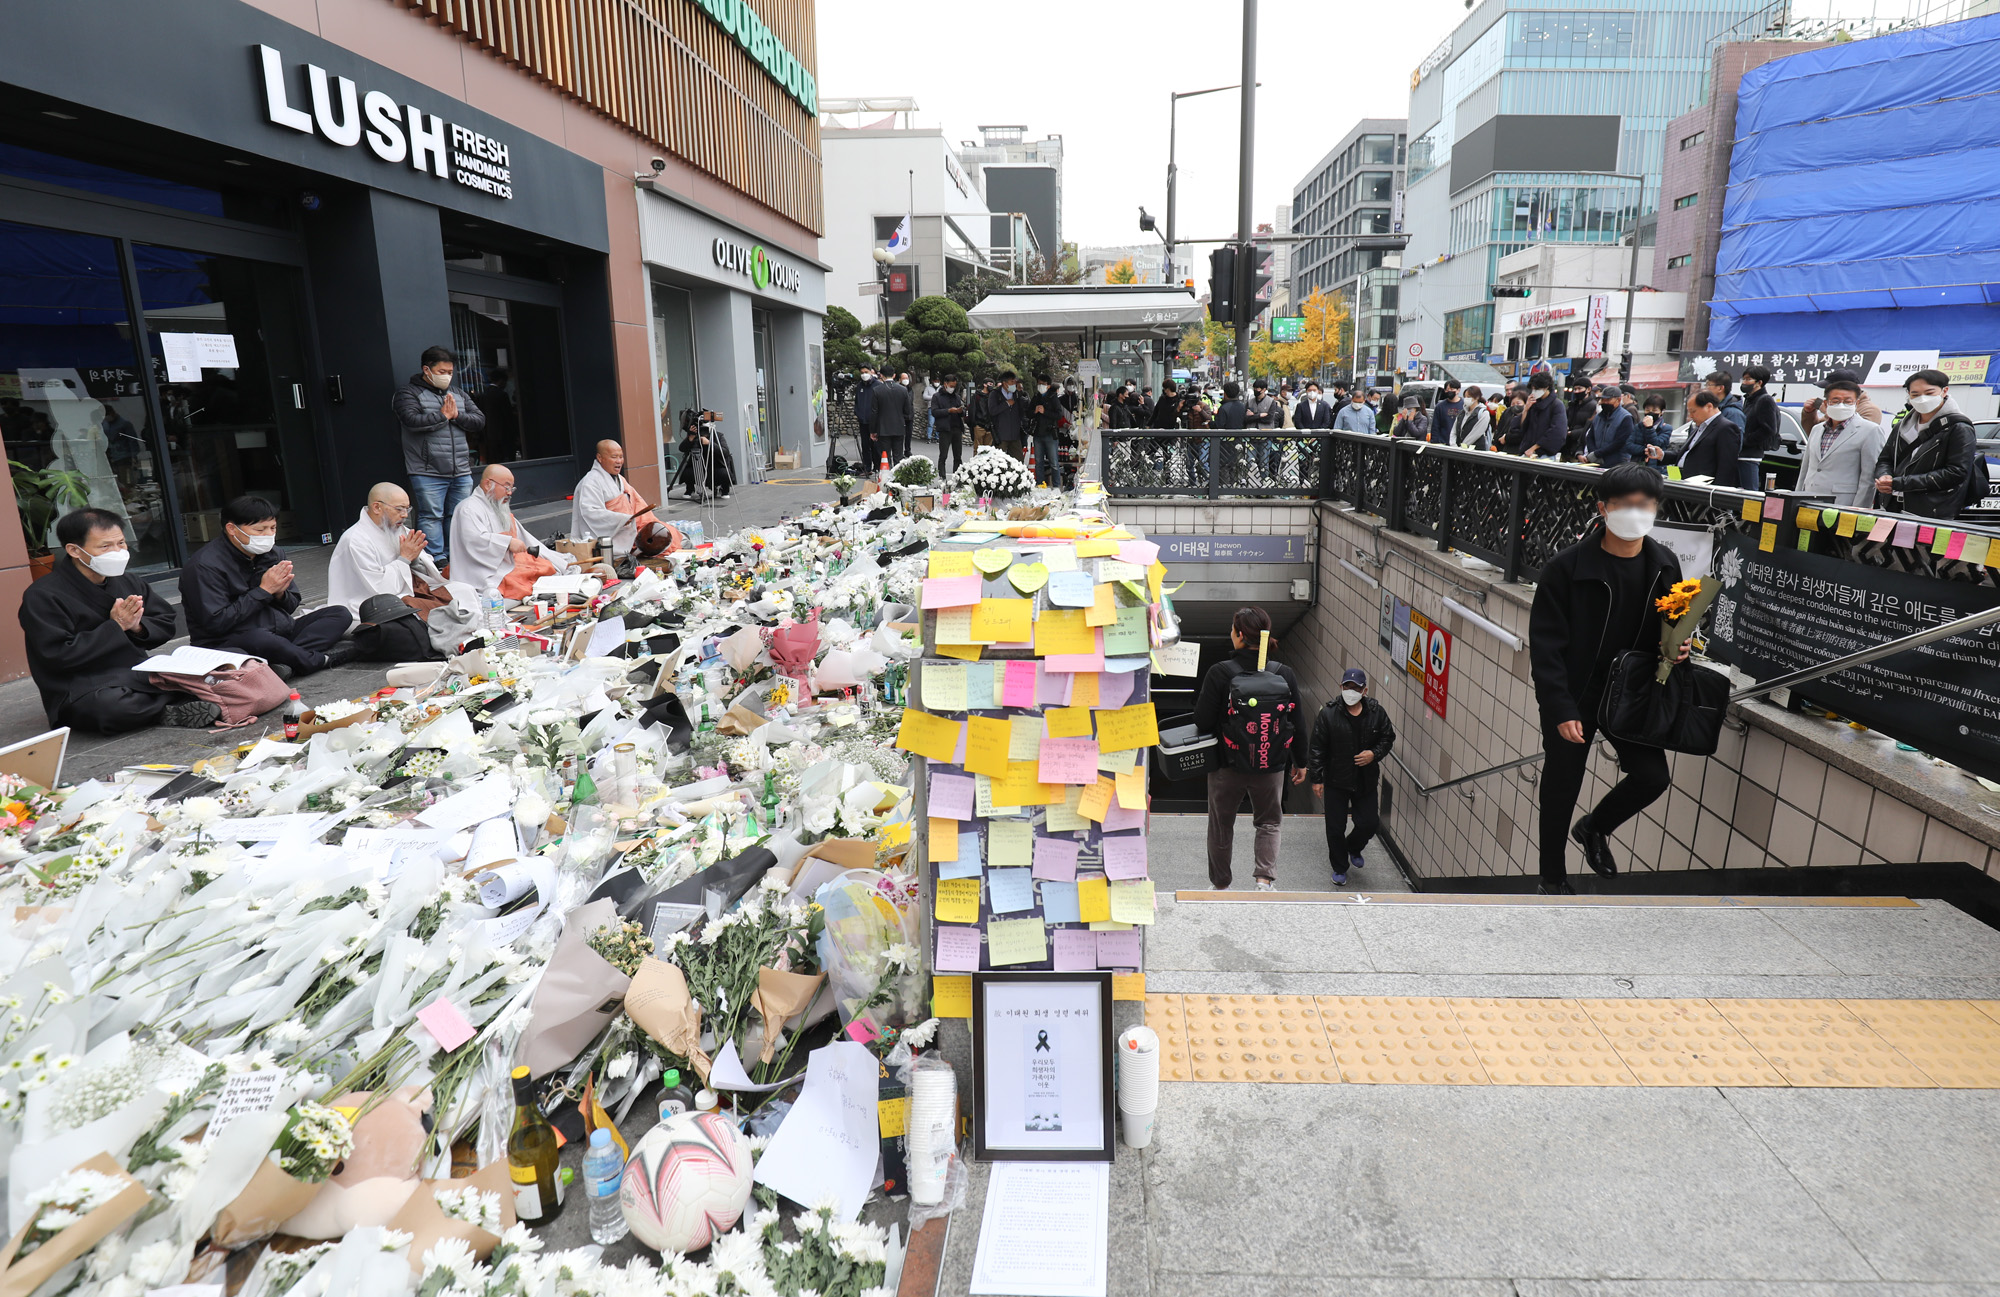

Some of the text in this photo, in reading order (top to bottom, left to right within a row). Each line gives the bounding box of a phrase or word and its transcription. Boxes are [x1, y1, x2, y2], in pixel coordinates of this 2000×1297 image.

[257, 43, 449, 179] LUSH
[450, 122, 510, 167] FRESH
[454, 151, 512, 184] HANDMADE
[456, 170, 513, 200] COSMETICS
[714, 238, 801, 292] OLIVE YOUNG
[1156, 312, 1179, 321] 용산구
[1590, 297, 1604, 352] TRANS
[1412, 346, 1421, 354] 50
[1722, 352, 1865, 368] 이태원 참사 희생자의
[1169, 541, 1210, 557] 이태원
[1214, 539, 1292, 552] Itaewon 1
[1747, 561, 1774, 584] 이태원
[1775, 569, 1799, 591] 참사
[1801, 575, 1867, 609] 희생자들께
[1870, 591, 1901, 617] 깊은
[1904, 600, 1959, 627] 애도를
[1750, 582, 1766, 594] send
[1766, 588, 1778, 597] our
[1778, 590, 1805, 607] deepest
[1806, 597, 1852, 618] condolences
[1853, 611, 1863, 621] to
[1864, 613, 1879, 625] the
[1880, 616, 1914, 633] victims
[1815, 615, 1829, 626] chia
[1426, 673, 1445, 697] 대피소
[1873, 664, 1913, 682] жертвам
[1914, 675, 1961, 693] трагедии
[1961, 686, 1973, 696] на
[1875, 678, 1923, 698] ЭМГЭНЭЛ
[1258, 712, 1272, 769] MoveSport
[1179, 752, 1205, 763] GOOSE
[1180, 758, 1206, 768] ISLAND
[1006, 1009, 1029, 1018] 이태원
[1034, 1009, 1050, 1018] 희생
[1032, 1066, 1056, 1074] 희생자의
